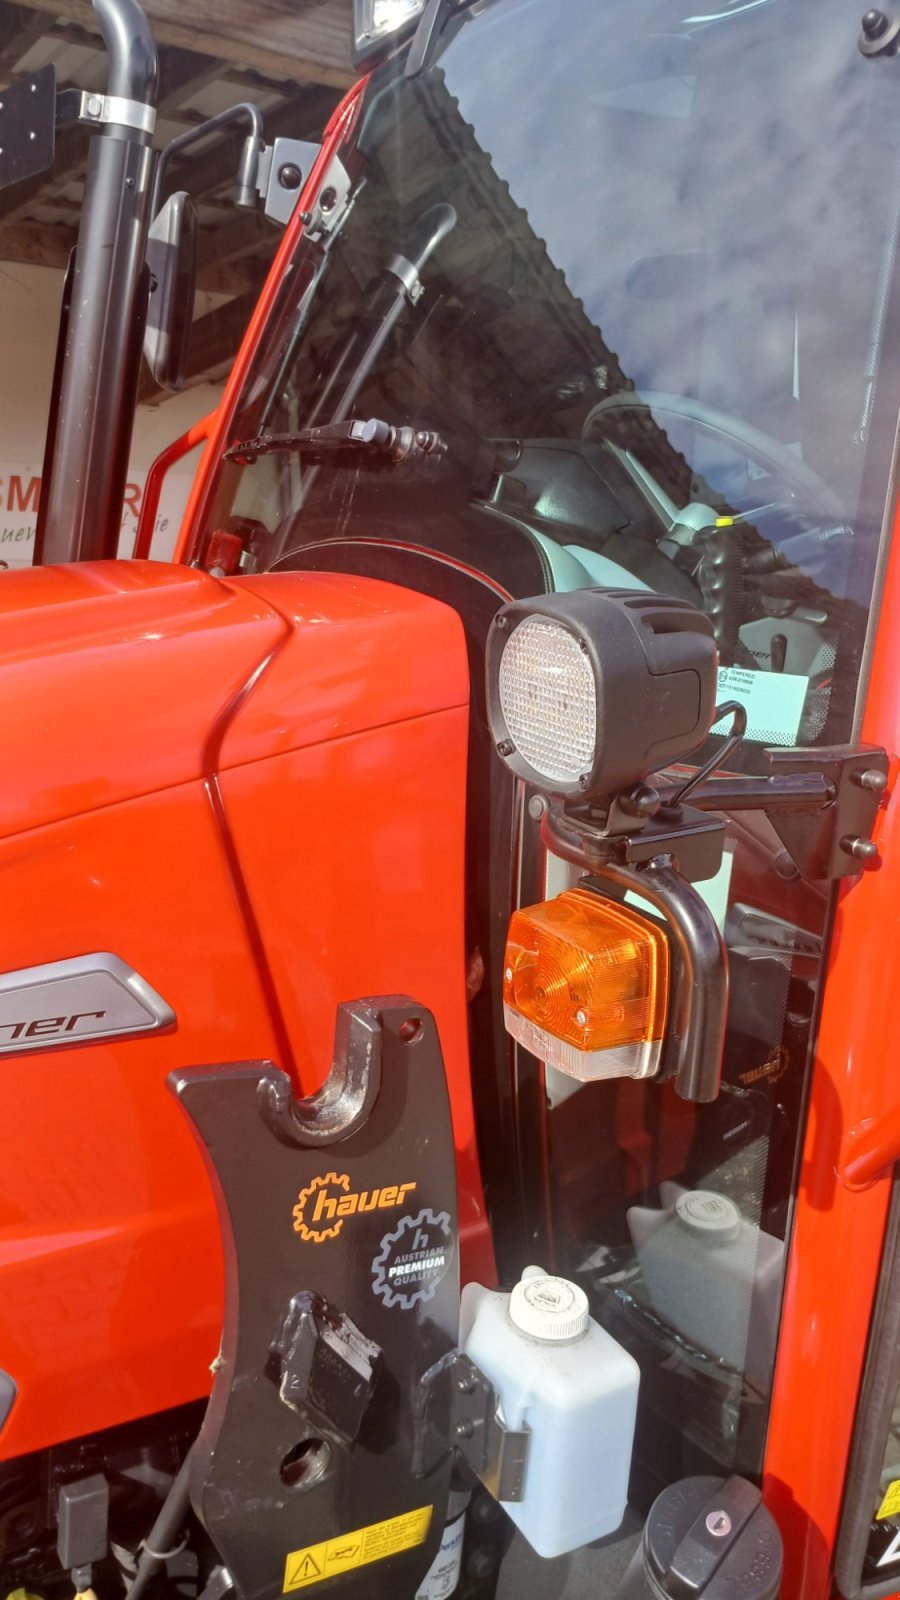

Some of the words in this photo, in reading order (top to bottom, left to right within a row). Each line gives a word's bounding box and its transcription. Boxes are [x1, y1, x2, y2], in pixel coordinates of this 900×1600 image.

[312, 1181, 417, 1222] hauer
[394, 1246, 444, 1265] AUSTRIAN
[388, 1256, 445, 1278] PREMIUM
[393, 1269, 439, 1286] QUALITY
